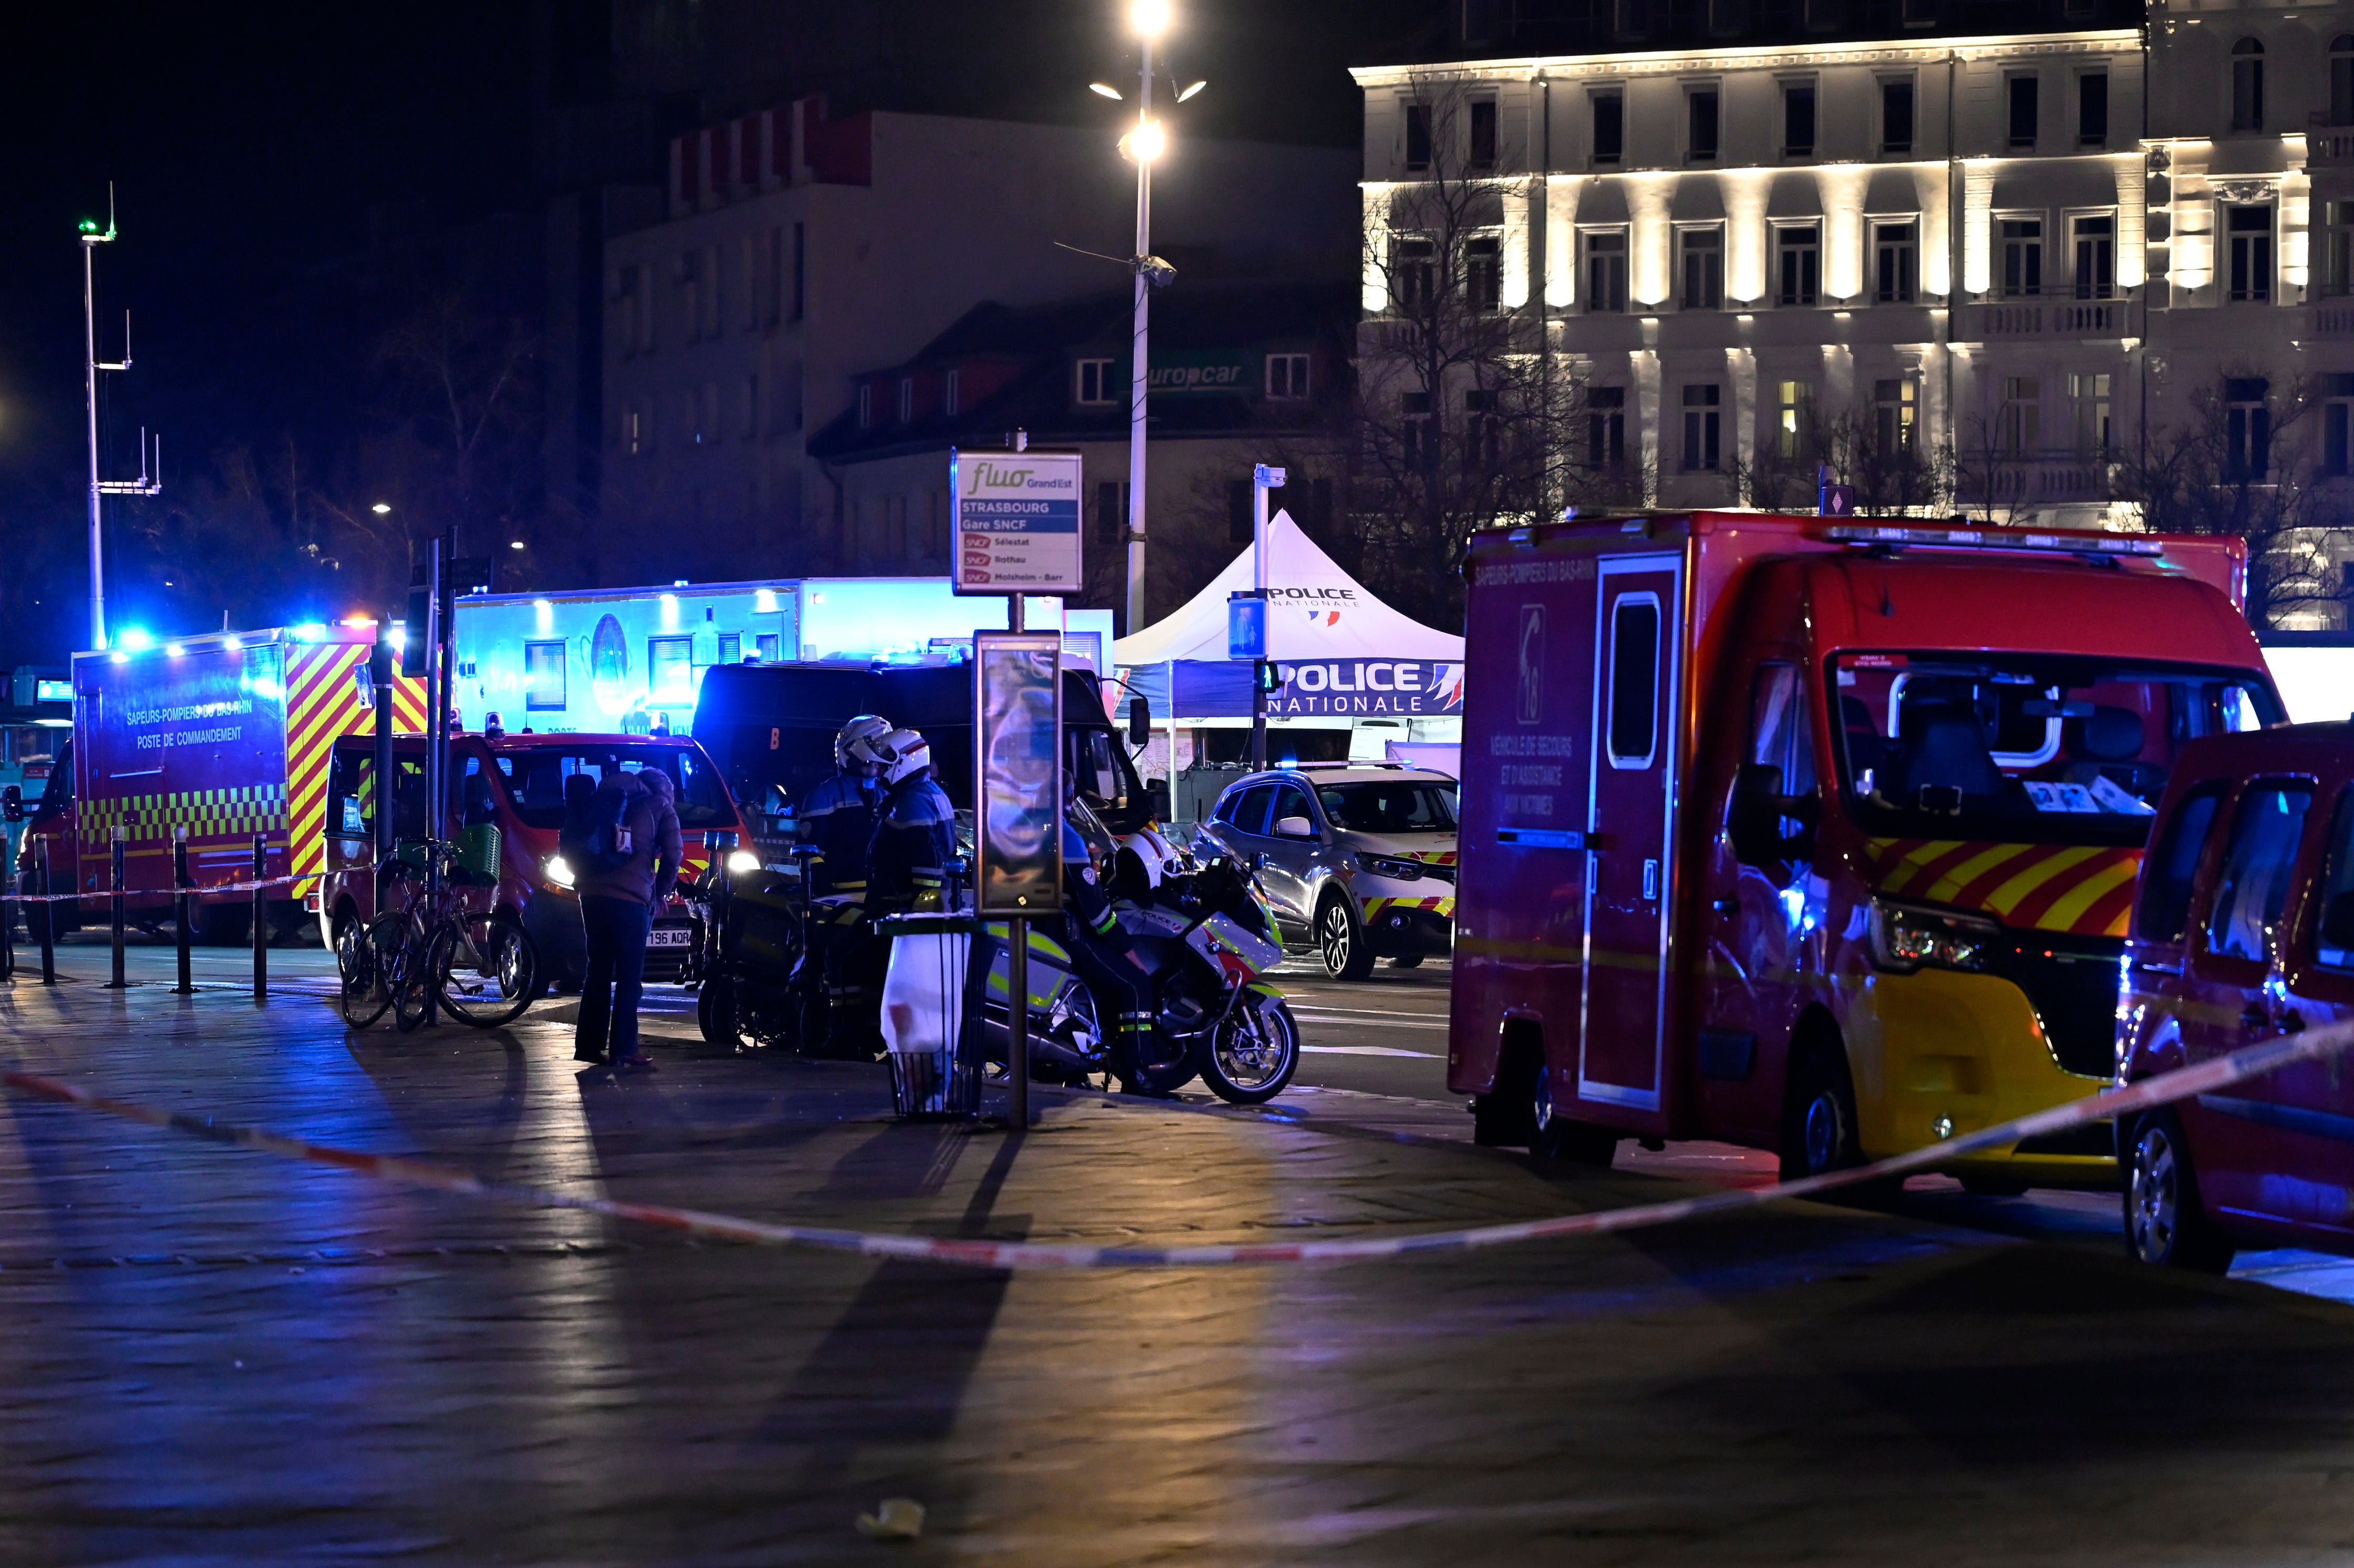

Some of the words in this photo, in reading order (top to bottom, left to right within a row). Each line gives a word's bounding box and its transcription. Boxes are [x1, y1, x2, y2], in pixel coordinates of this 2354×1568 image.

[1148, 366, 1242, 388] uropcar
[967, 462, 1034, 496] fluo
[962, 502, 1049, 513] STRASBOURG
[962, 519, 990, 530] Gare
[994, 519, 1027, 530] SNCF
[1267, 588, 1356, 600] POLICE
[127, 705, 201, 726] SAPEURS-POMPIERS
[216, 699, 252, 717] BAS-RHIN
[1267, 696, 1422, 712] NATIONALE
[137, 734, 161, 749] POSTE
[163, 733, 174, 747] DE
[177, 726, 242, 746] COMMANDEMENT
[770, 727, 780, 750] B
[649, 932, 668, 944] 196
[671, 932, 689, 944] AQR
